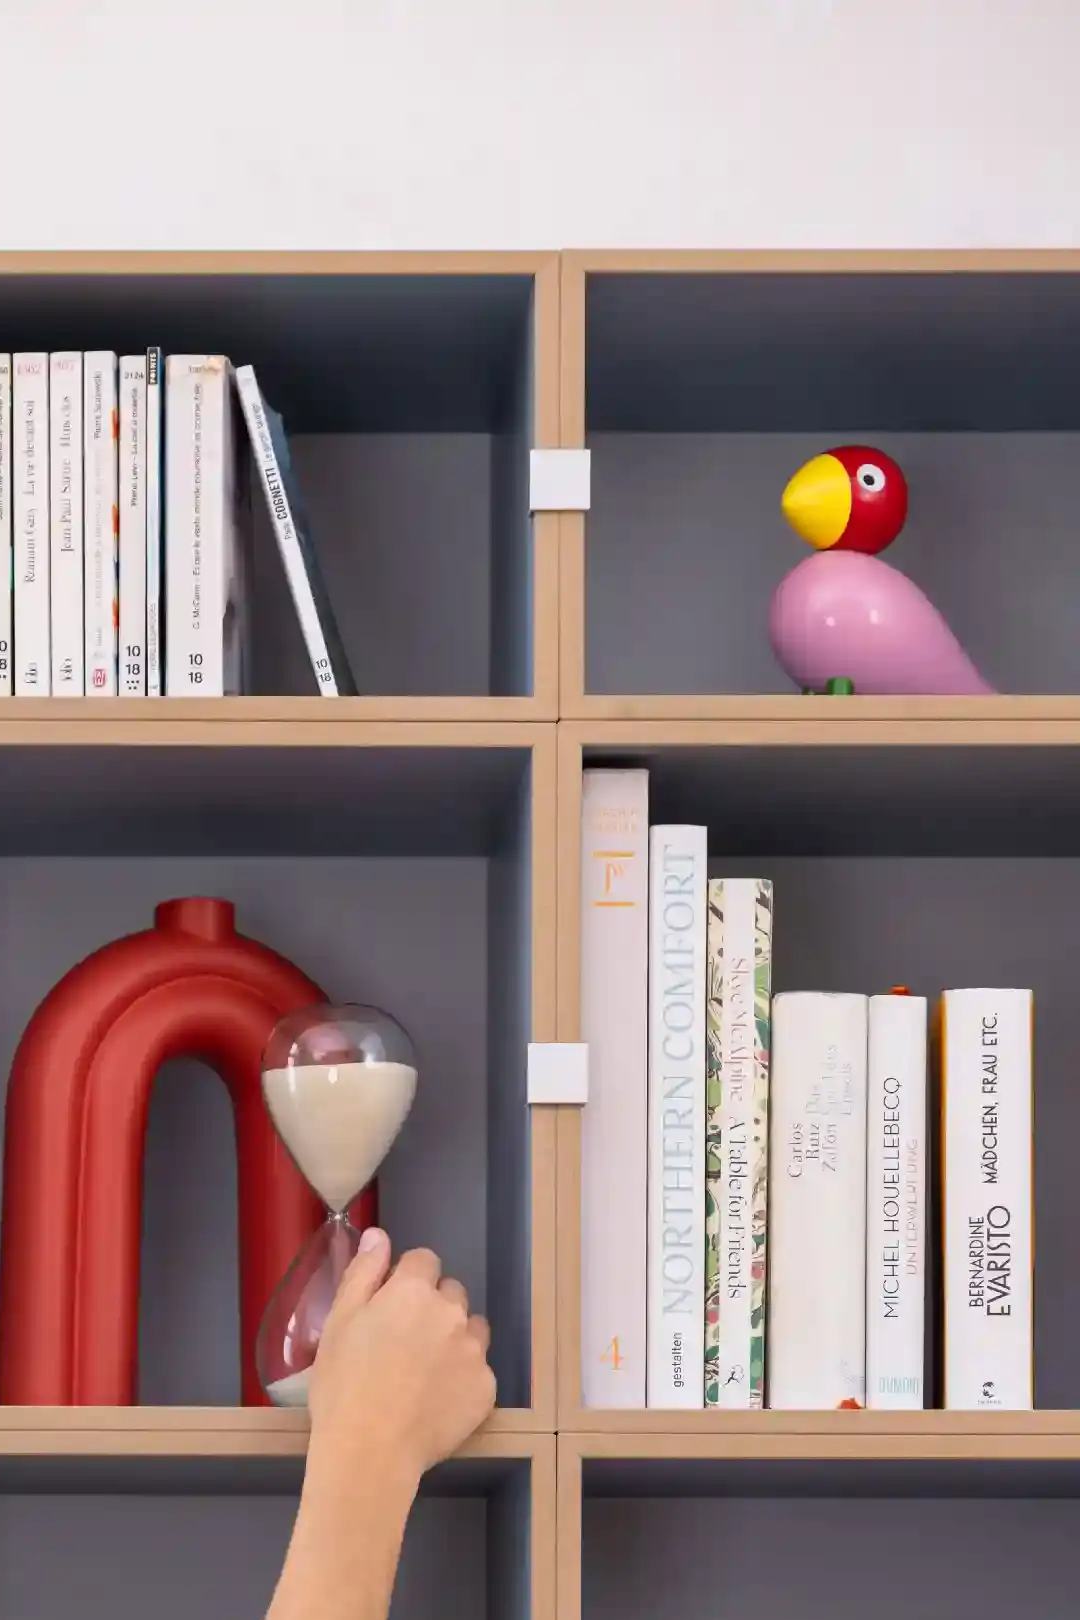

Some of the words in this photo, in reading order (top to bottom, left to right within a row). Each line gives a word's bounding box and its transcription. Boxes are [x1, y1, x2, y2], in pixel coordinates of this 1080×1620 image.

[265, 468, 288, 520] COGNETTI
[126, 664, 141, 675] 18
[127, 645, 141, 657] 10
[188, 653, 203, 665] 10
[319, 672, 332, 683] 18
[188, 672, 203, 684] 18
[661, 844, 695, 1062] COMFORT
[982, 1012, 998, 1046] ETC.
[982, 1054, 998, 1094] FRAU
[728, 1115, 746, 1132] A
[786, 1122, 804, 1178] Carlos
[805, 1123, 820, 1160] Ruiz
[980, 1102, 999, 1184] MÄDCHEN,
[728, 1136, 747, 1191] Table
[883, 1077, 902, 1232] HOUELLEBECQ
[661, 1075, 694, 1315] NORTHERN
[728, 1194, 747, 1221] for
[727, 1227, 748, 1299] Friends
[883, 1239, 900, 1319] MICHEL
[969, 1216, 985, 1307] BERNARDINE
[985, 1205, 1012, 1316] EVARISTO
[672, 1332, 684, 1388] gestalten
